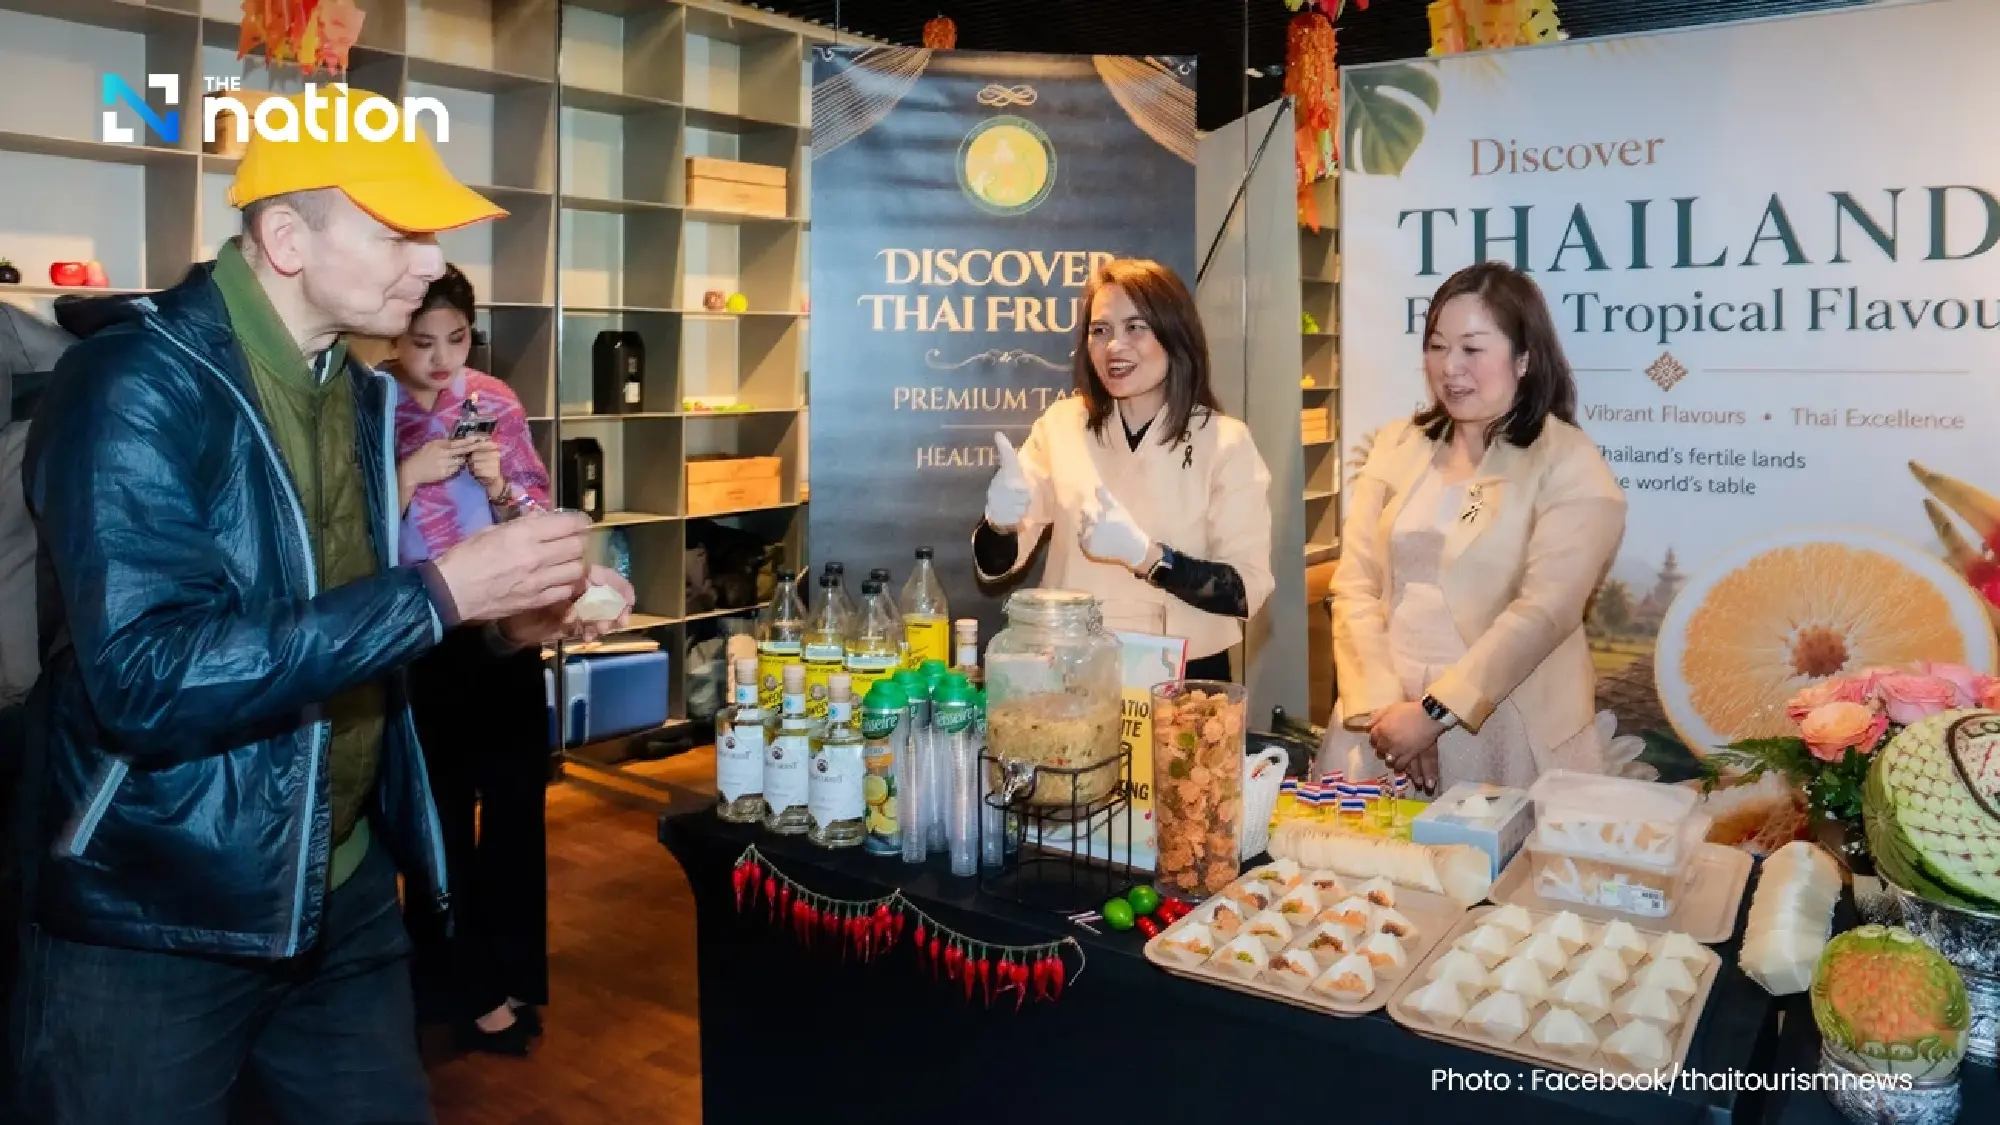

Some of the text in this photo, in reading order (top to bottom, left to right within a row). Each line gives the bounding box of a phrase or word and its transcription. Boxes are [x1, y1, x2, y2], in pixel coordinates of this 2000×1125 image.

[1470, 137, 1666, 177] Discover
[1397, 184, 2000, 276] THAILAND
[857, 294, 975, 333] THAI
[1562, 287, 1786, 346] Tropical
[893, 386, 1081, 412] PREMIUM TA
[1584, 403, 1965, 430] Vibrant Flavours Thai Excellence
[1688, 447, 1746, 467] fertile
[1752, 449, 1806, 469] lands
[1636, 475, 1703, 493] world's
[1708, 477, 1757, 495] table
